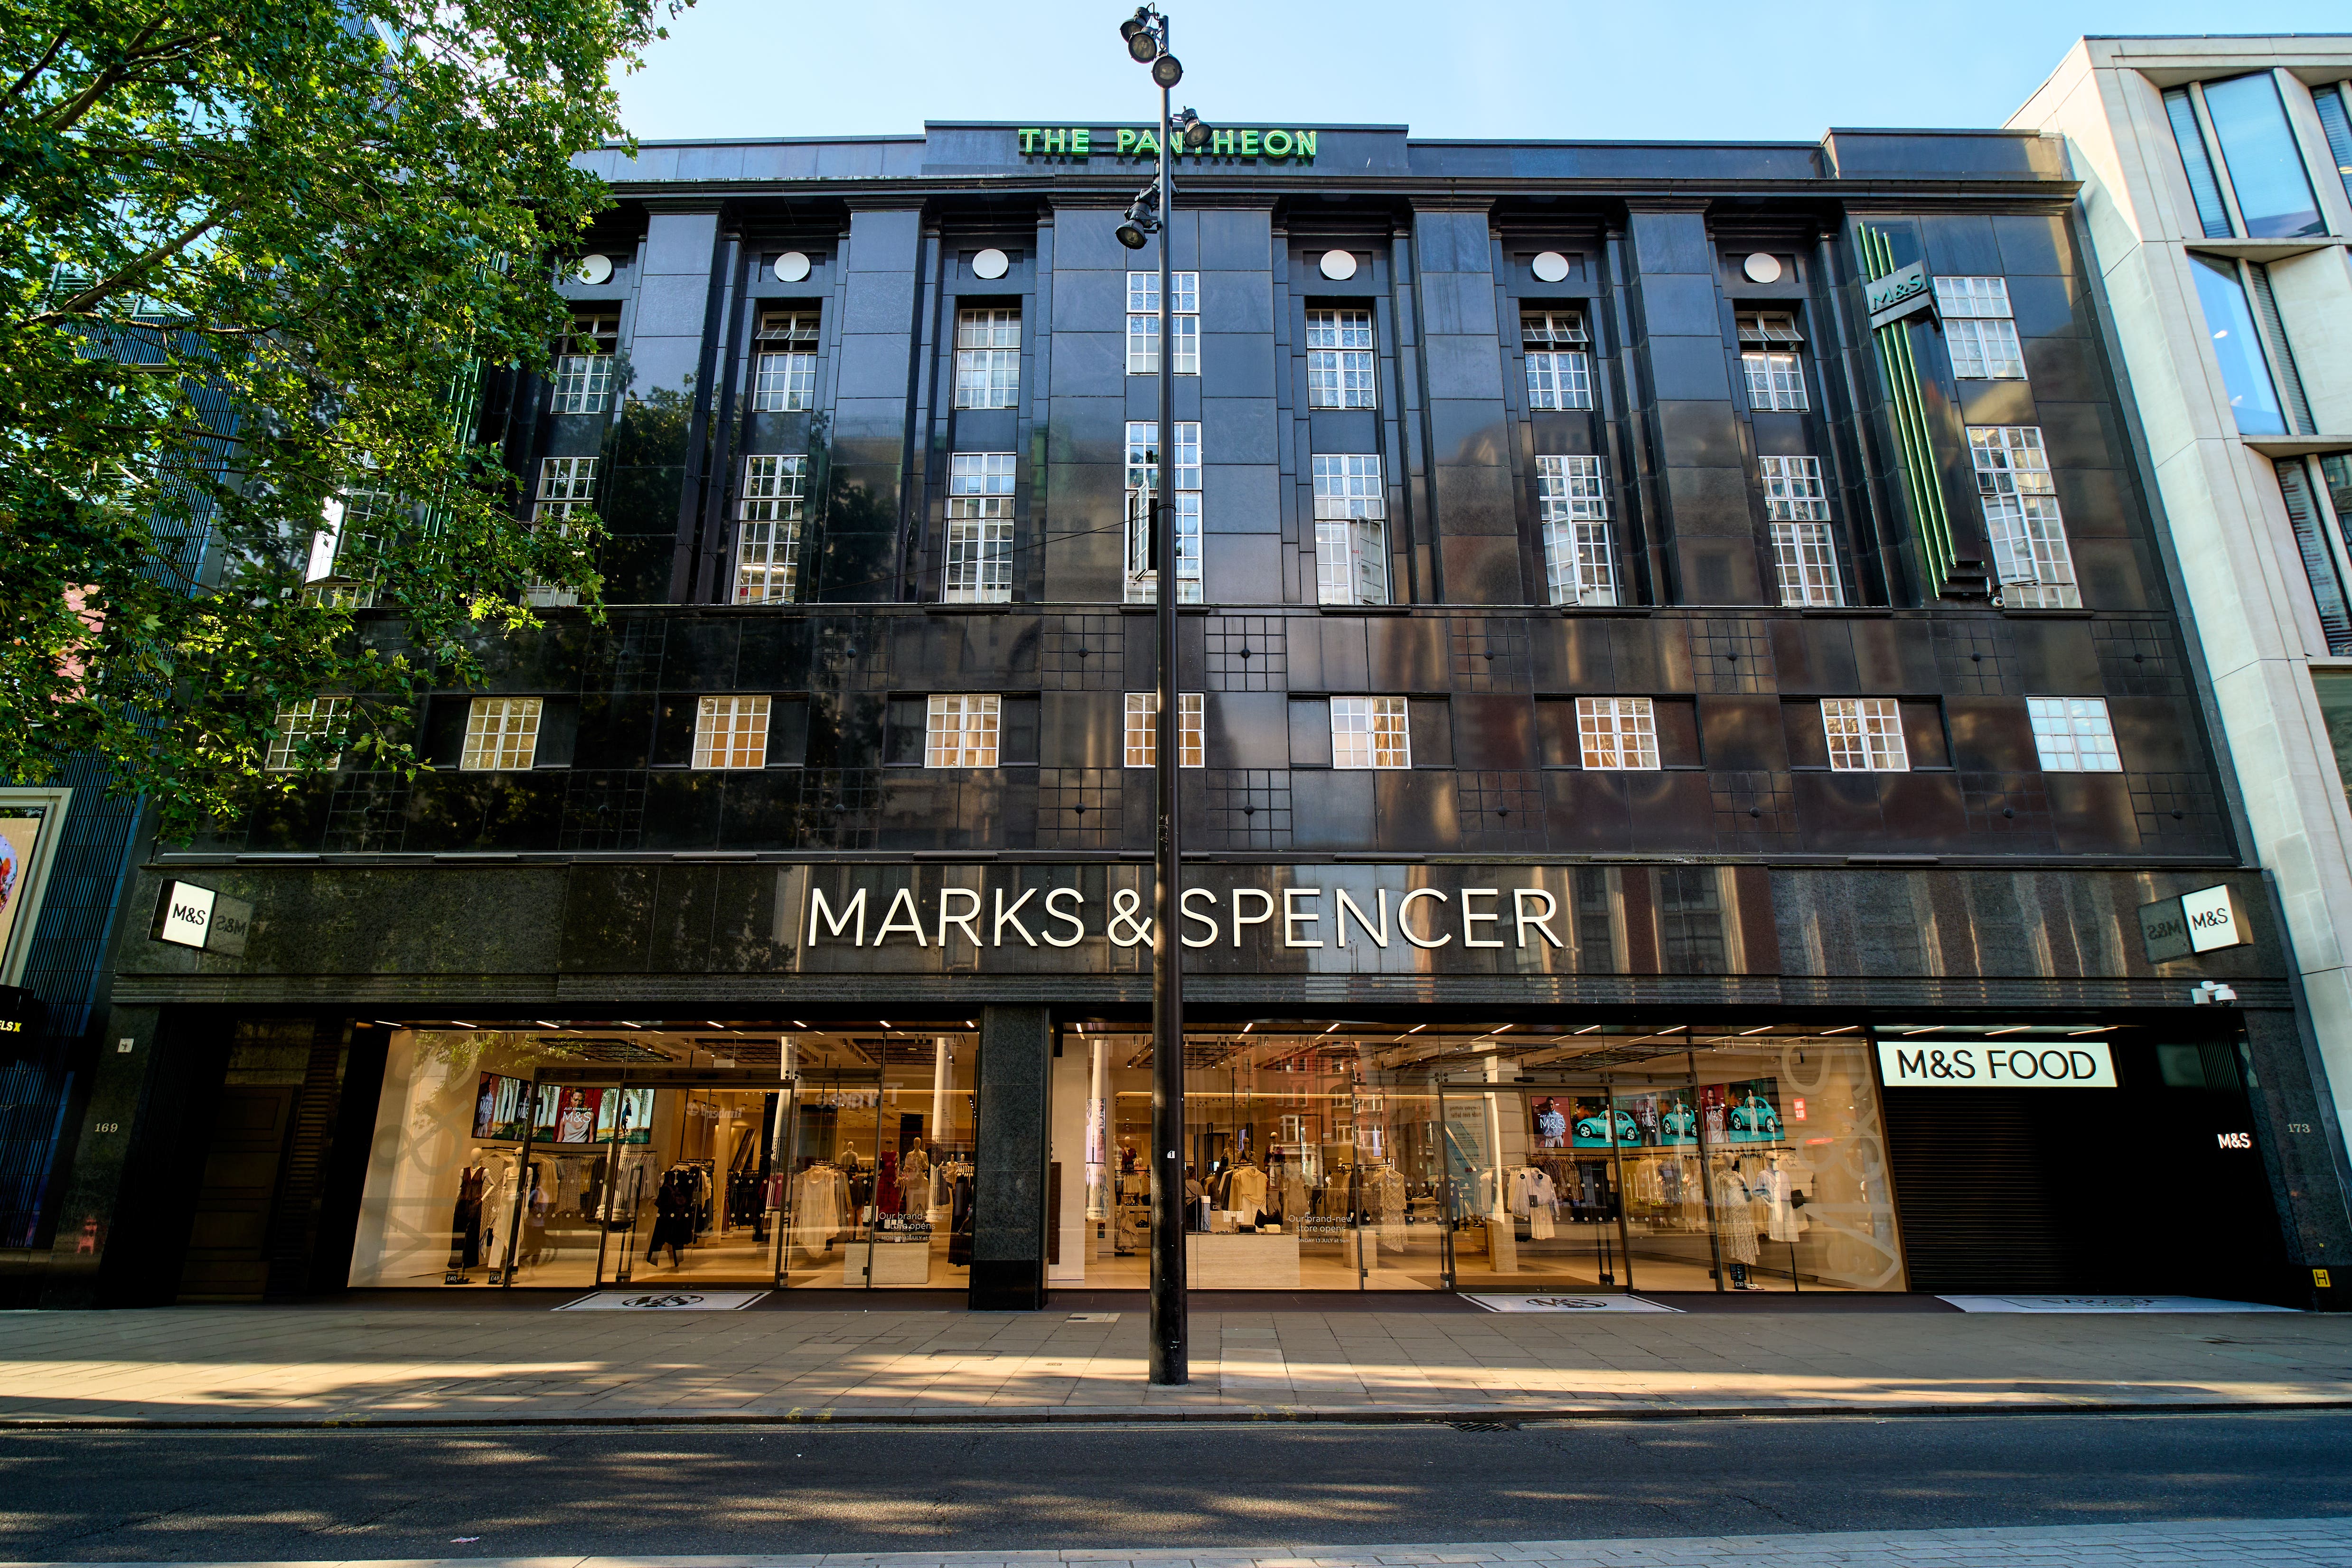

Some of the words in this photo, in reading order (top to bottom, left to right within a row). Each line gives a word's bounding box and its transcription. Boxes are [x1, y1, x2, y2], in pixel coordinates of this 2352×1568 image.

[1018, 129, 1089, 152] THE
[1117, 129, 1317, 156] PANHEON
[1873, 273, 1922, 310] M&S
[172, 903, 206, 925] M&S
[808, 888, 1085, 948] MARKS
[1107, 888, 1154, 948] &
[1181, 888, 1565, 948] SPENCER
[2191, 908, 2229, 930] M&S
[1896, 1049, 1976, 1080] M&S
[1985, 1049, 2097, 1080] FOOD
[479, 1101, 492, 1114] M&S
[562, 1111, 591, 1123] M&S
[1641, 1116, 1656, 1127] M&S
[1706, 1109, 1724, 1122] M&S
[95, 1123, 118, 1133] 169
[1540, 1118, 1565, 1128] M&S
[2287, 1123, 2311, 1133] 173
[2217, 1132, 2252, 1149] M&S
[1307, 1214, 1352, 1222] brand-new
[911, 1222, 936, 1230] opens
